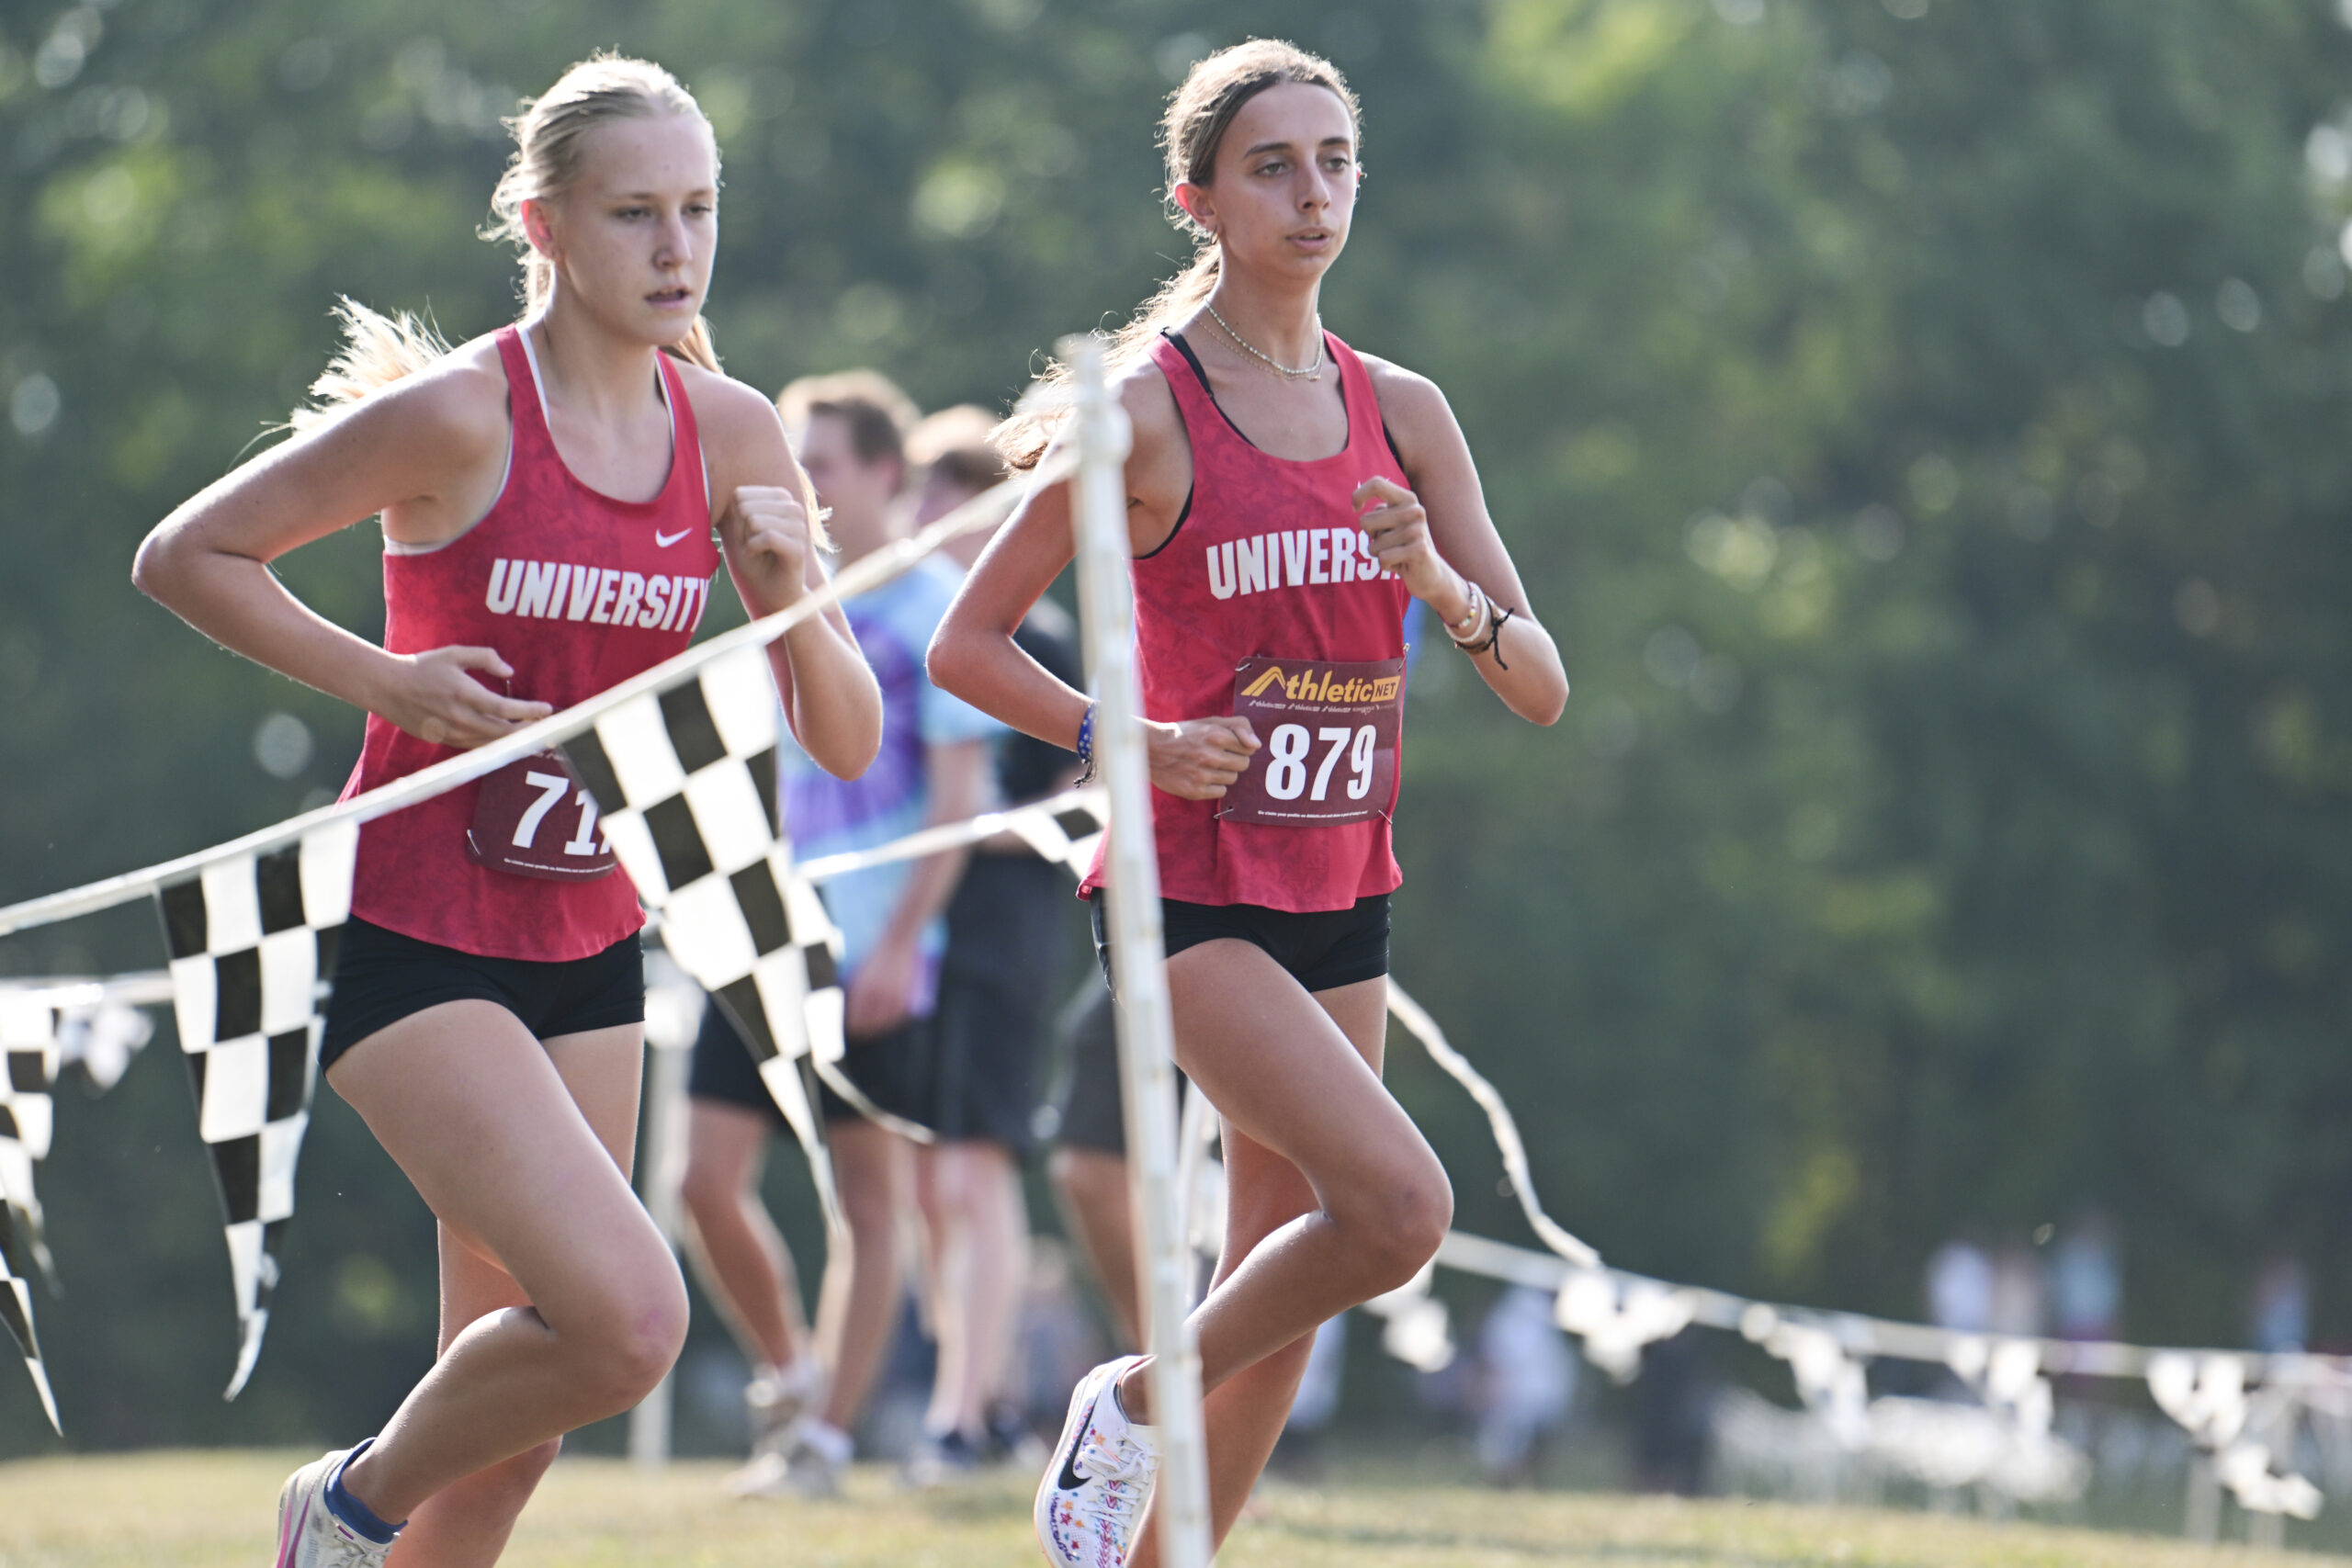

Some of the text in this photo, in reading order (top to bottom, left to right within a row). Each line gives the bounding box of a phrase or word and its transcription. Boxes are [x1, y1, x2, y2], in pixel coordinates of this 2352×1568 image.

[1206, 527, 1402, 601] UNIVERS
[1265, 723, 1376, 801] 879
[512, 771, 612, 856] 71
